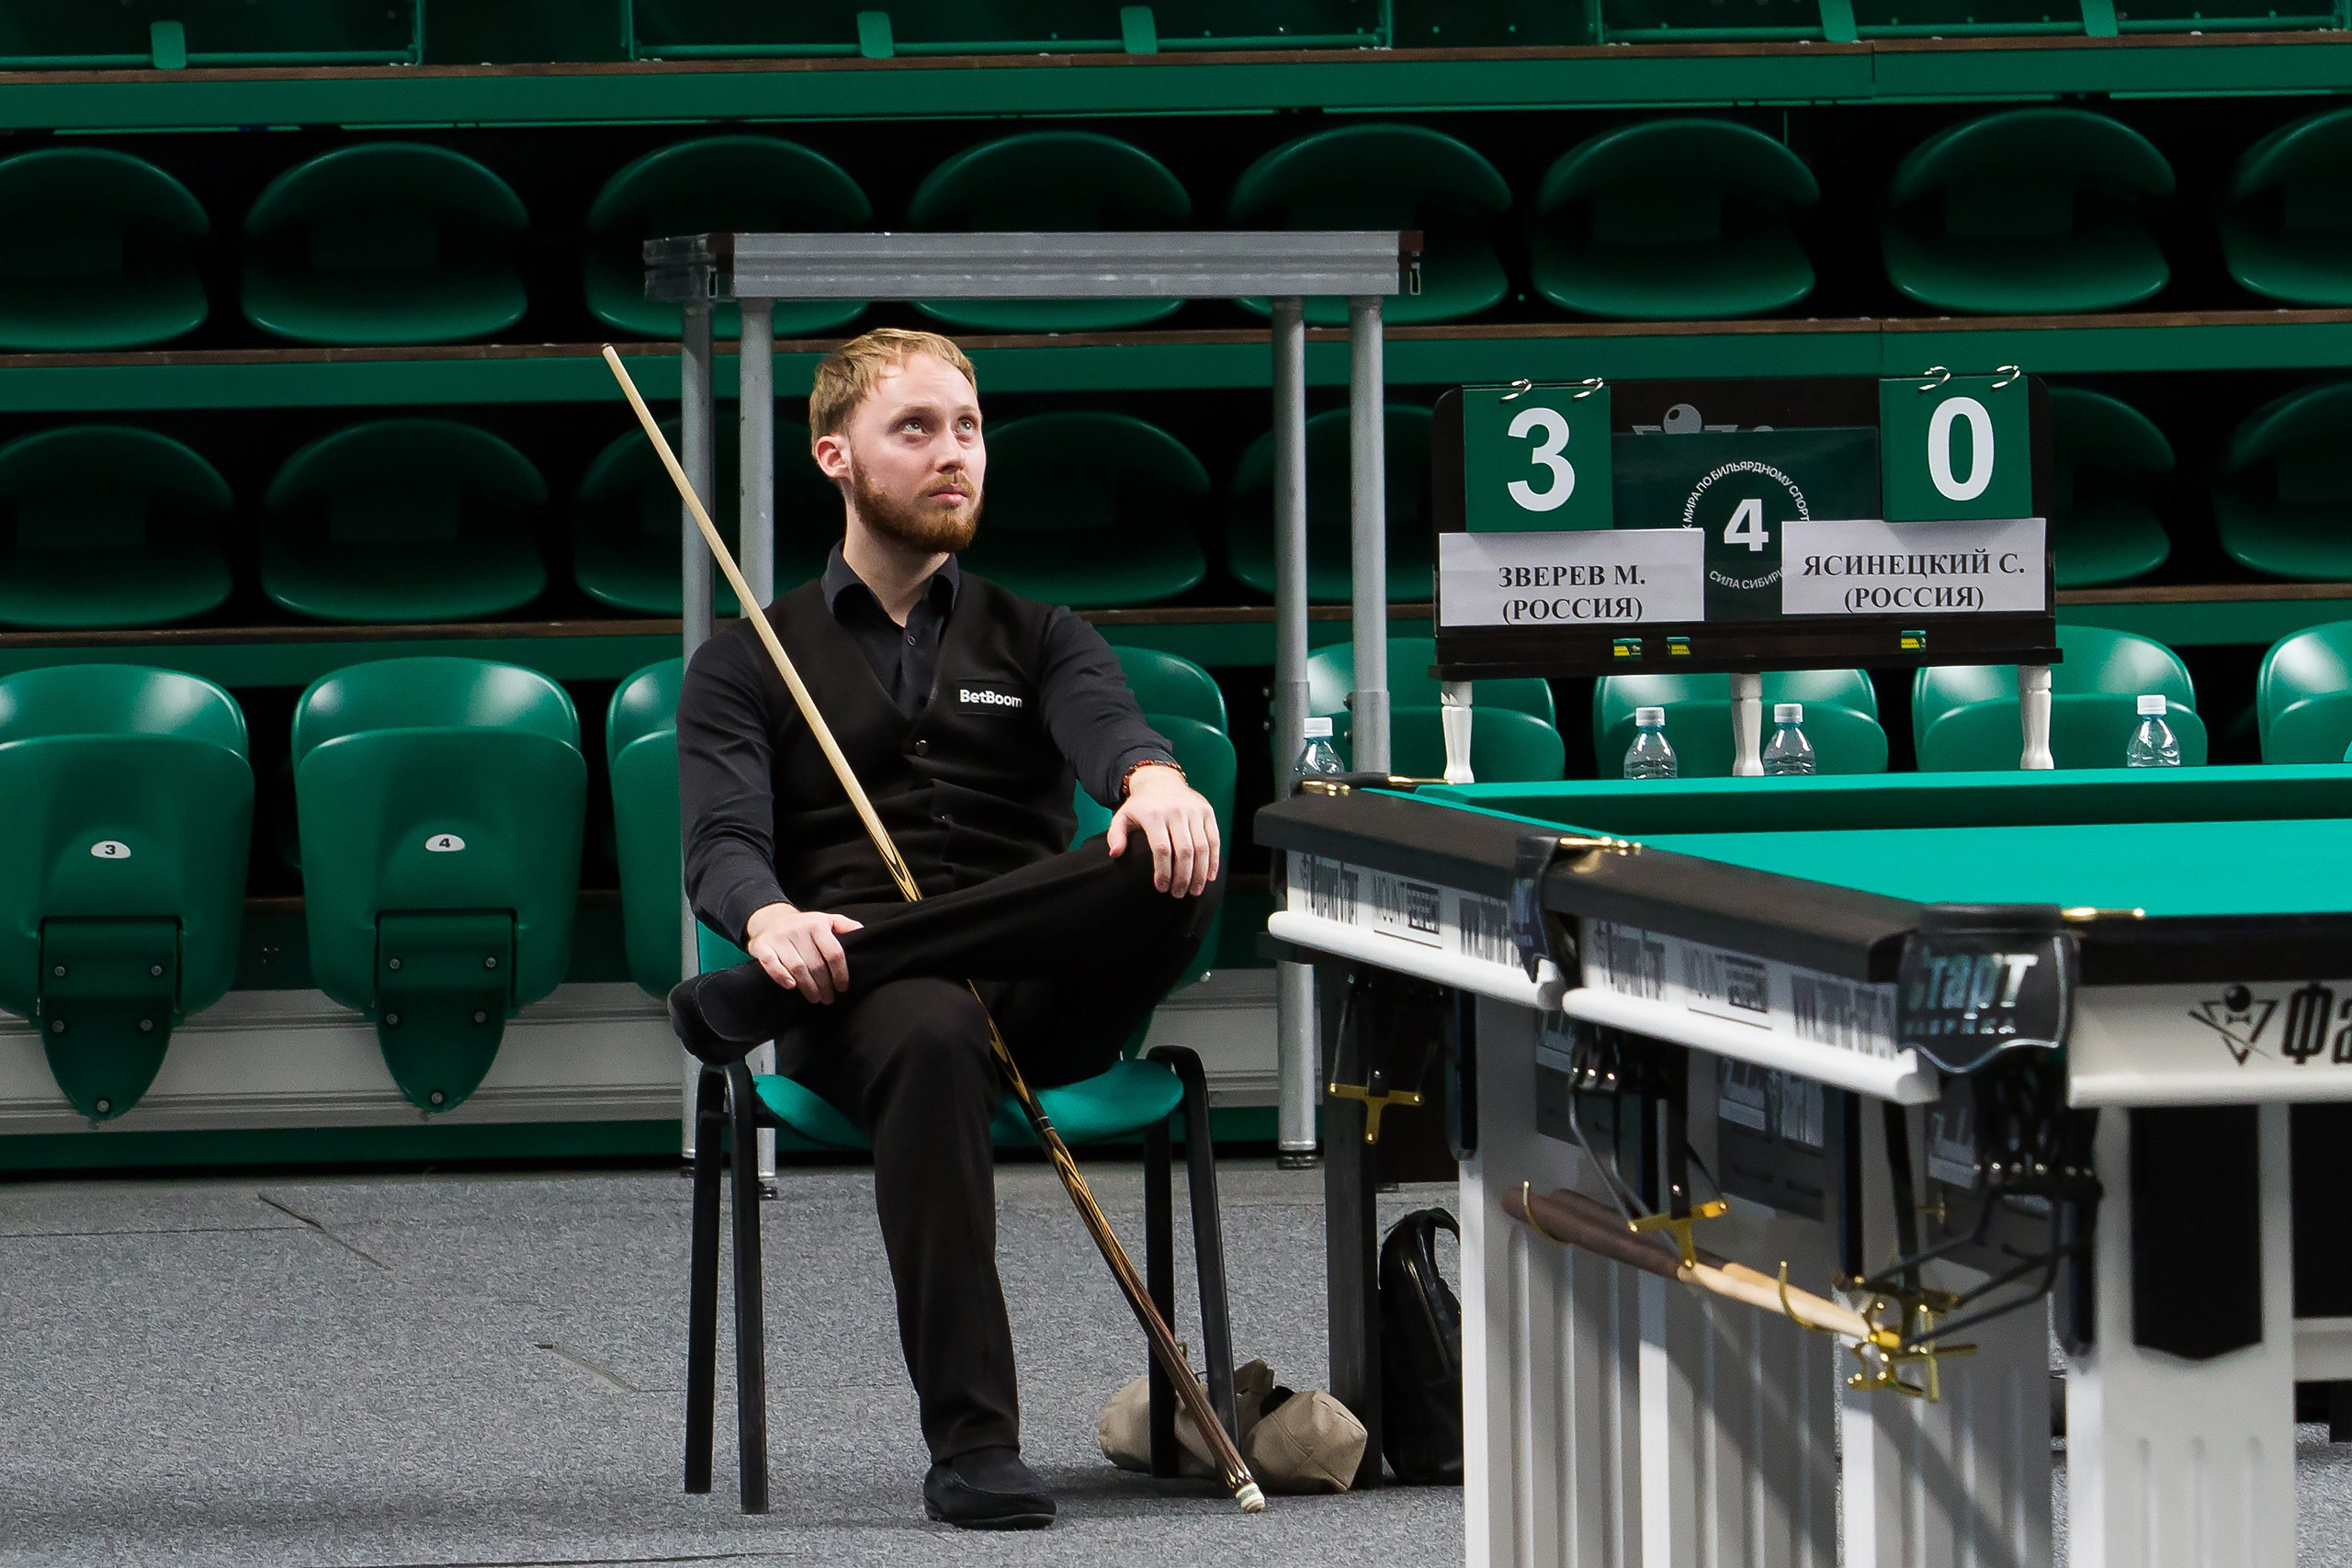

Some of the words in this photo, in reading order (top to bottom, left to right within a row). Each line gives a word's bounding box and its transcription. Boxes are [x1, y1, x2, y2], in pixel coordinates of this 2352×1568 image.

[1507, 407, 1576, 512] 3
[1928, 397, 1996, 502] 0
[1682, 492, 1702, 526] МИРА
[1696, 476, 1713, 493] ПО
[1710, 461, 1792, 487] БИЛЬЯРДНОМУ
[1789, 485, 1810, 522] СПОРТ
[1724, 499, 1770, 551] 4
[1498, 565, 1605, 588] ЗВЕРЕВ
[1614, 564, 1645, 585] М.
[1803, 548, 1991, 580] ЯСИНЕЦКИЙ
[1999, 553, 2025, 574] С.
[1709, 570, 1740, 589] СИЛА
[1502, 597, 1643, 625] (РОССИЯ)
[1844, 586, 1984, 613] (РОССИЯ)
[960, 689, 1023, 707] BetBoom
[105, 844, 116, 855] 3
[439, 838, 451, 848] 4
